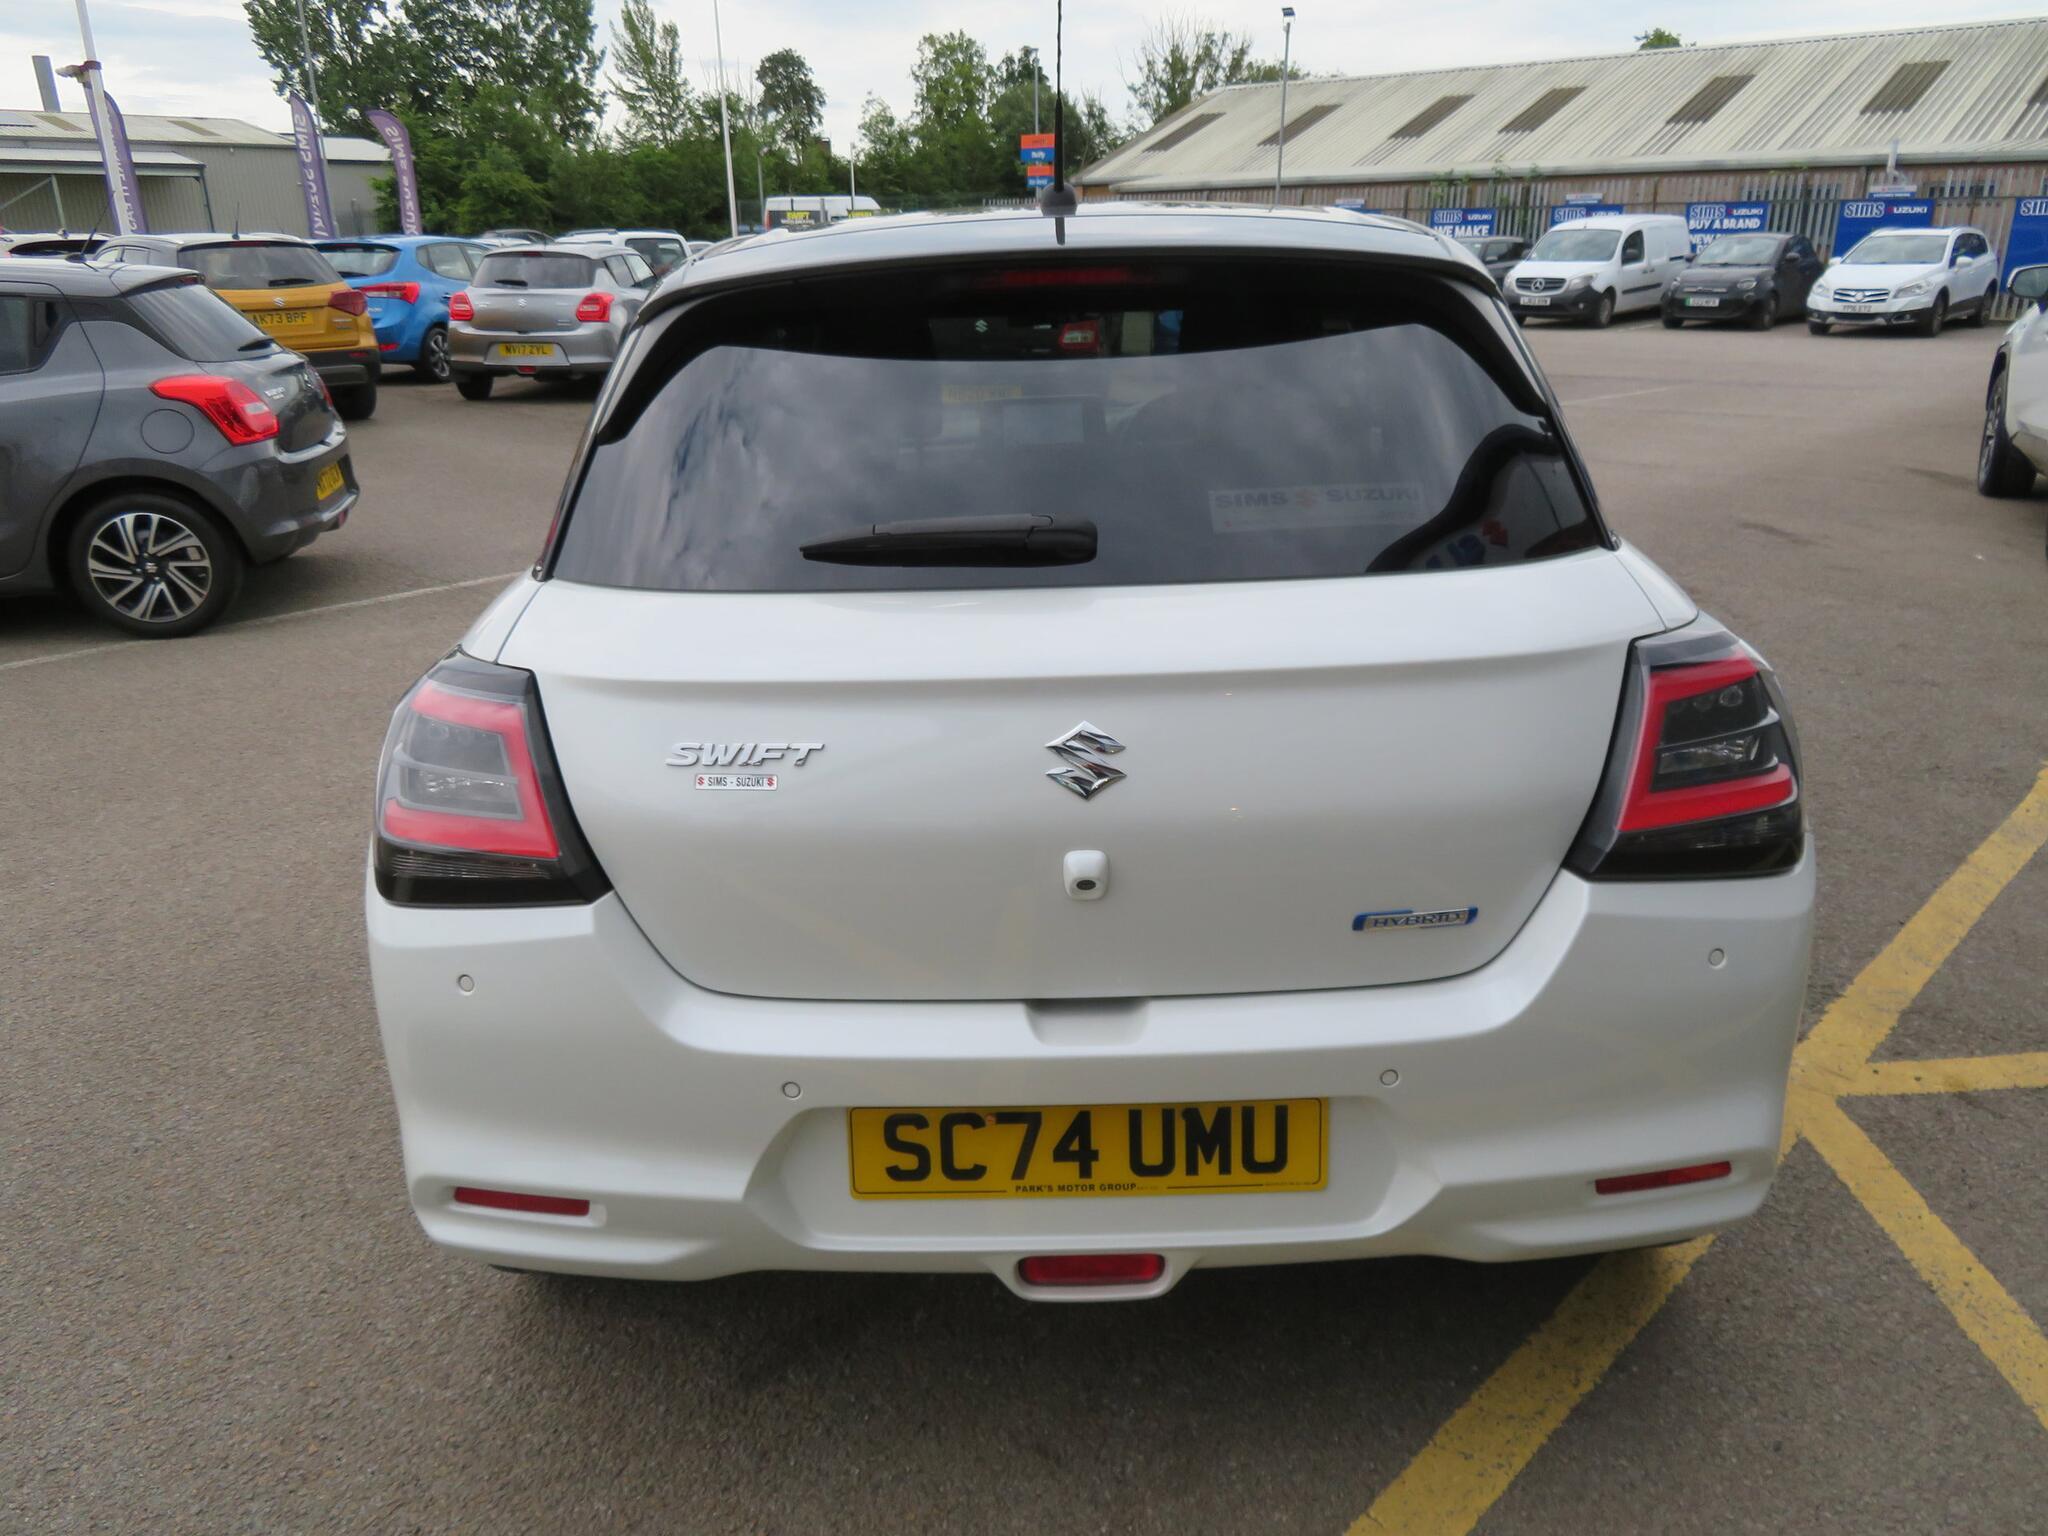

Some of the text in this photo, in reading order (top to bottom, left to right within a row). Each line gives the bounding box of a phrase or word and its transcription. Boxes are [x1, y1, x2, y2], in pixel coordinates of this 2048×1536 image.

[1689, 218, 1761, 230] BUY A BRAND
[1455, 225, 1489, 238] MAKE
[1214, 491, 1288, 509] SIMS
[665, 742, 825, 767] SWIFT
[707, 776, 728, 788] SIMS
[736, 776, 765, 788] SUZUKI
[1373, 912, 1463, 927] HYBRID
[883, 1104, 1289, 1182] SC74 UMU
[1015, 1184, 1054, 1193] PARK'S
[1057, 1183, 1096, 1193] MOTOR
[1099, 1182, 1137, 1192] GROUP
